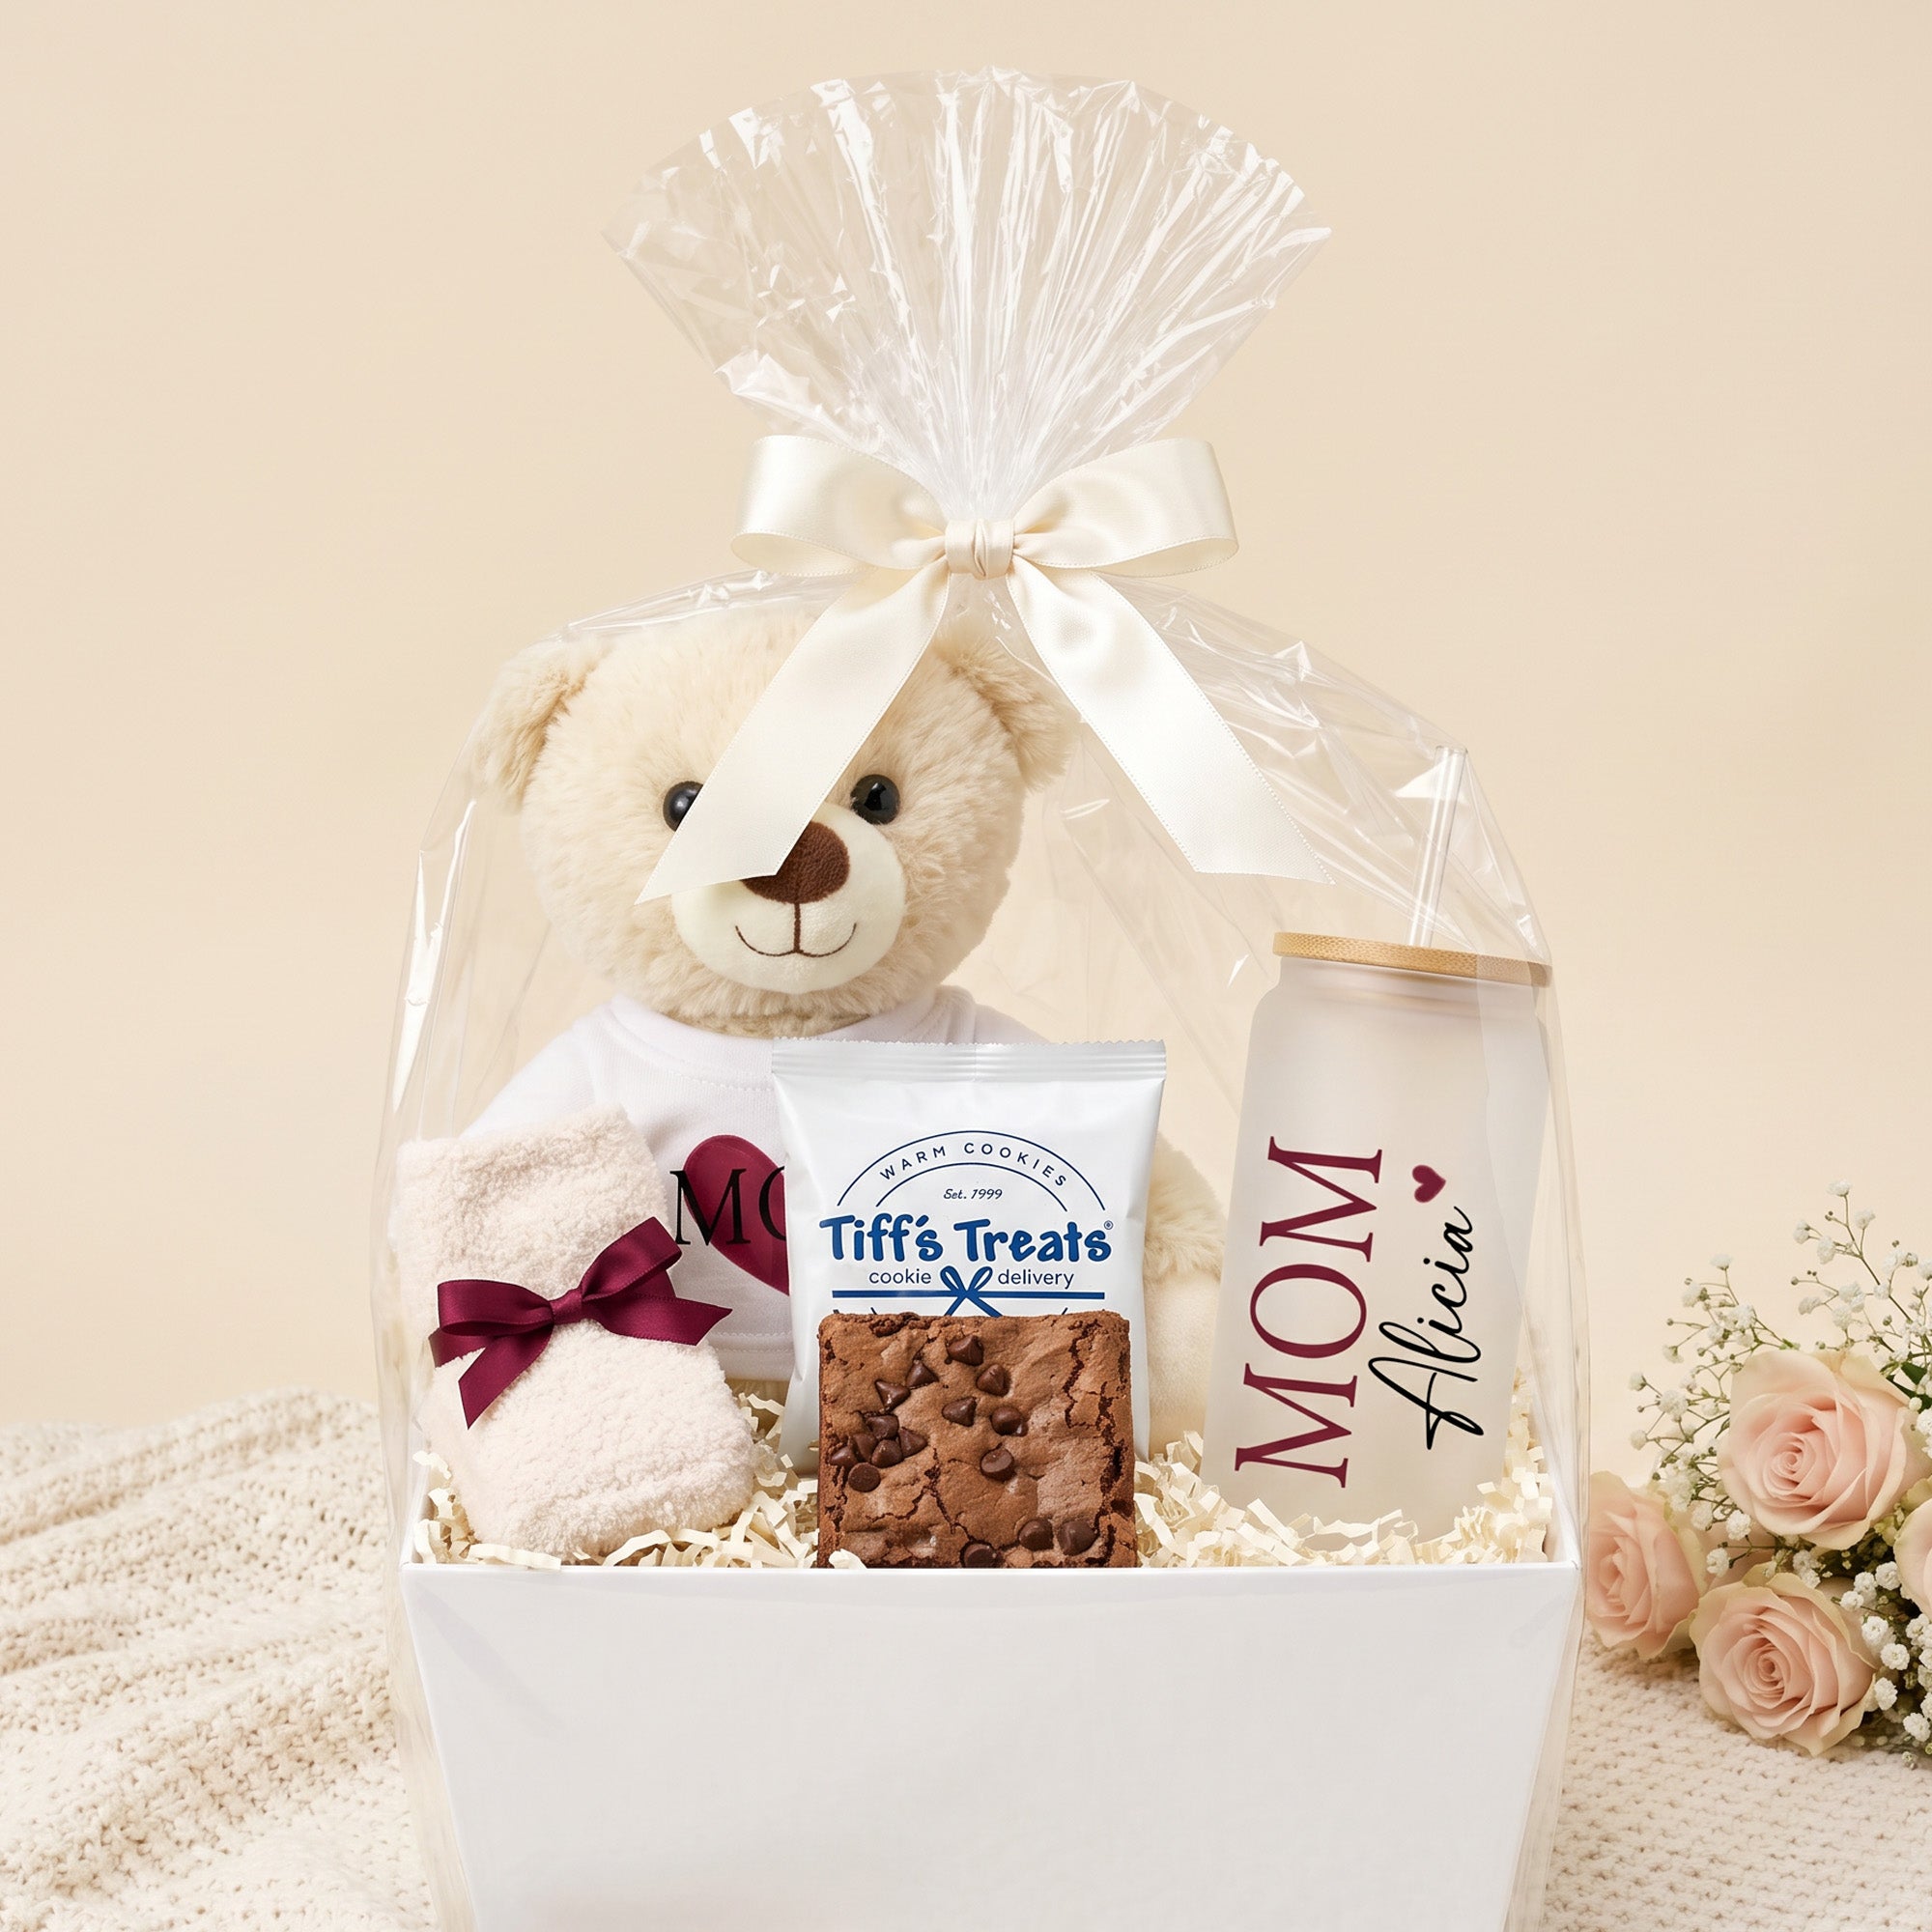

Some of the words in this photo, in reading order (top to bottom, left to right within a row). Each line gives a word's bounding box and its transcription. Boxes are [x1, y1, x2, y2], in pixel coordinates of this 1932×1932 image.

[880, 1145, 947, 1180] WARM
[963, 1142, 1067, 1187] COOKIES
[943, 1188, 967, 1200] Set.
[971, 1188, 1003, 1200] 1999
[819, 1213, 944, 1263] Tiff's
[868, 1268, 932, 1286] cookie
[997, 1269, 1074, 1290] delivery
[1235, 1135, 1382, 1489] MOM
[1368, 1206, 1484, 1450] Alicia
